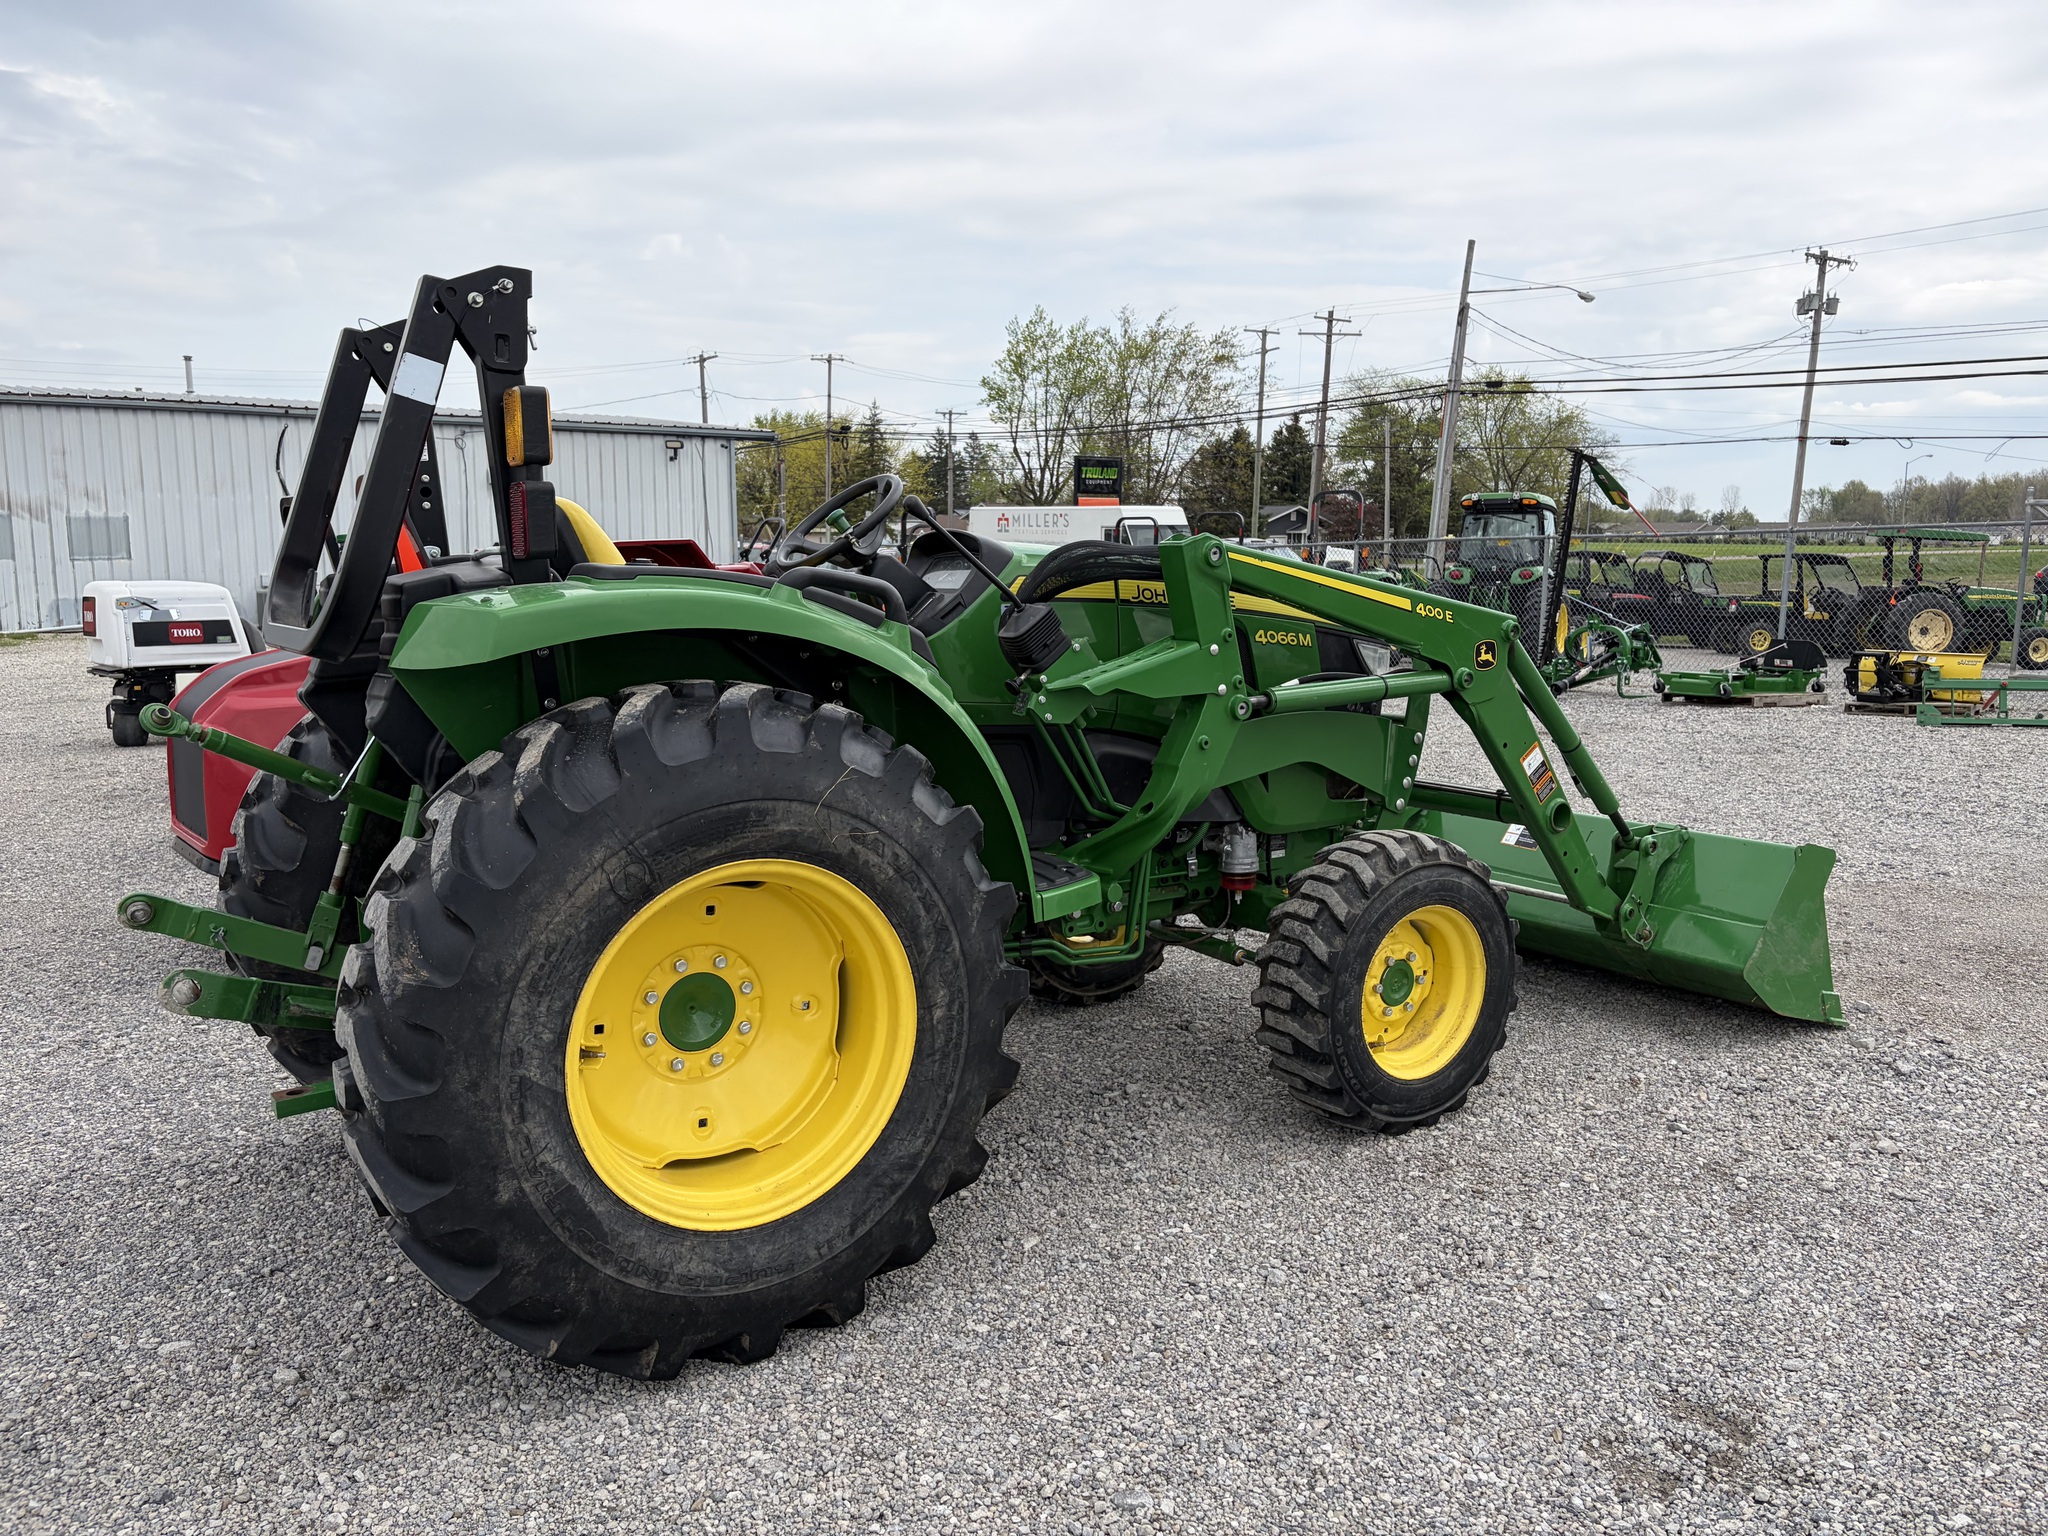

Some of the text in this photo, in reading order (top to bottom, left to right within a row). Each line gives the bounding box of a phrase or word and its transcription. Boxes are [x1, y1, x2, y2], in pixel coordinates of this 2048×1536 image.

[1081, 466, 1118, 479] TRULAND
[1012, 513, 1070, 528] MILLER'S
[1131, 585, 1168, 603] JOH
[84, 610, 94, 622] TORO
[1416, 602, 1454, 623] 400 E
[171, 628, 201, 638] TORO
[1254, 629, 1312, 647] 4066 M
